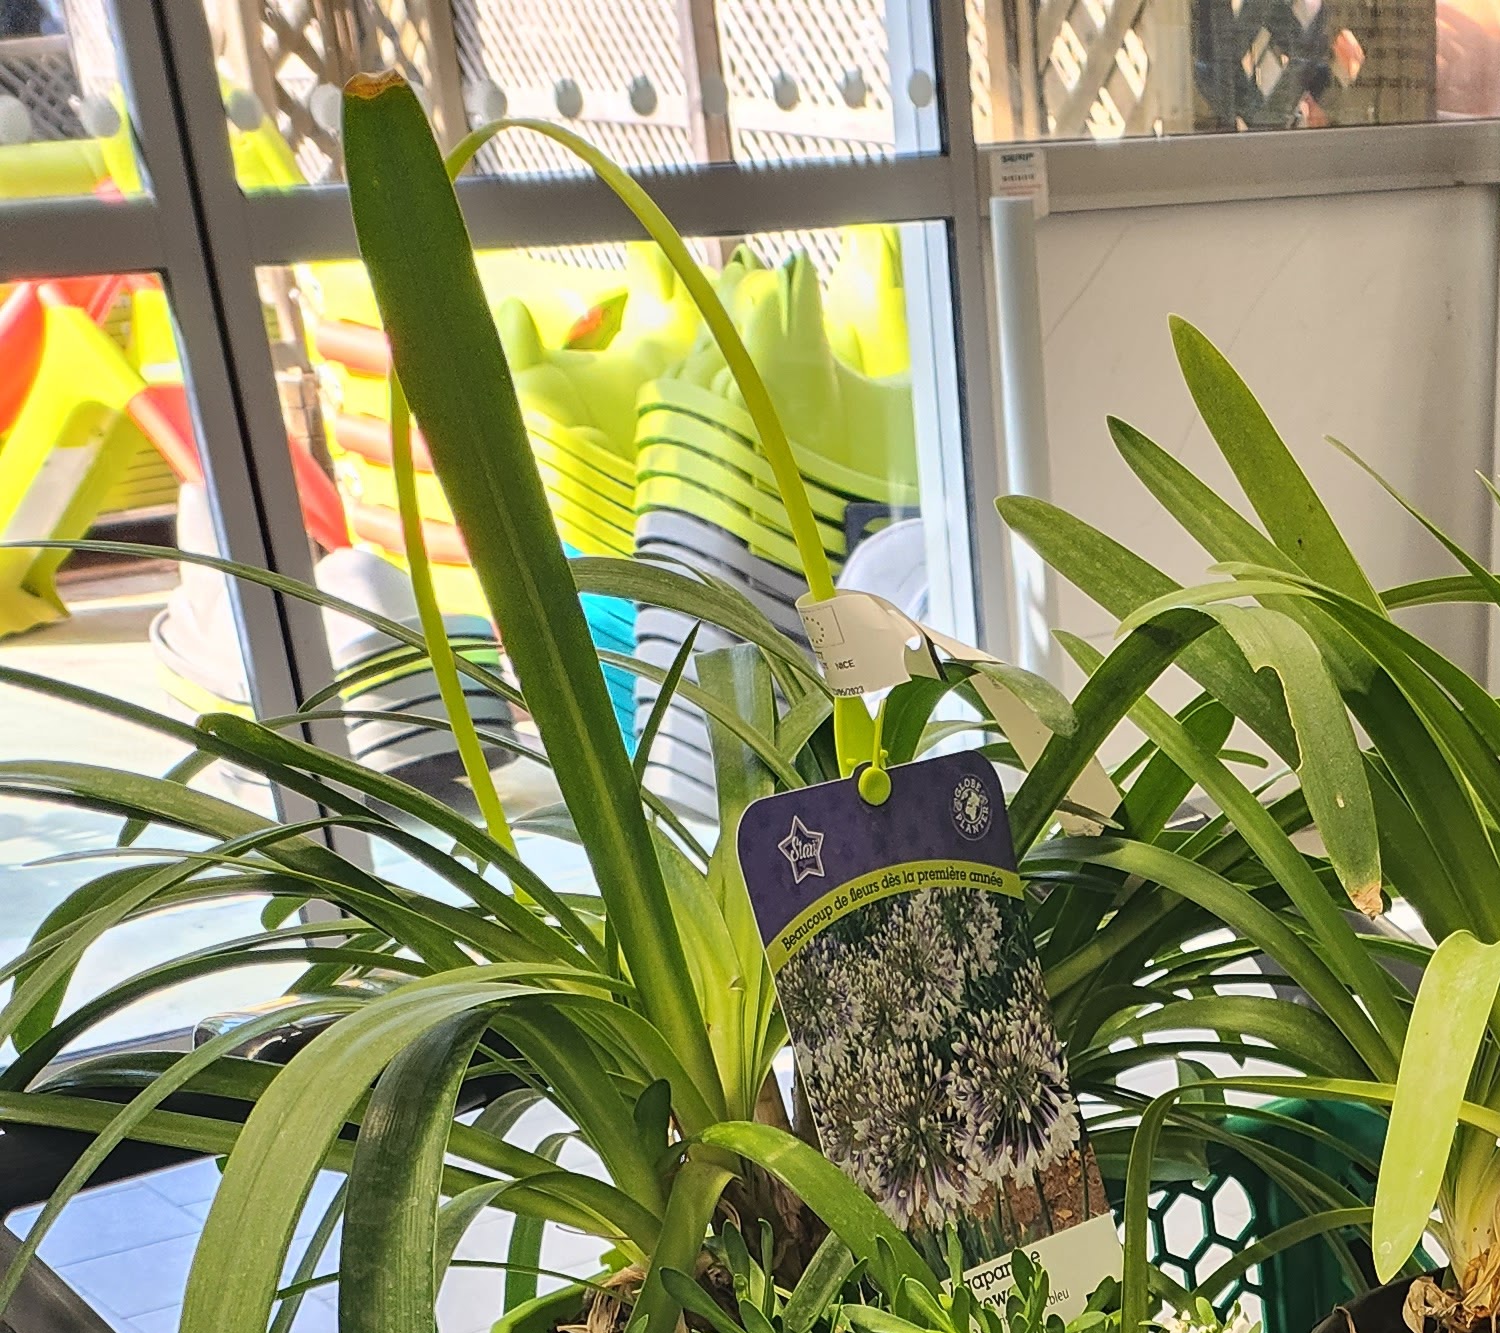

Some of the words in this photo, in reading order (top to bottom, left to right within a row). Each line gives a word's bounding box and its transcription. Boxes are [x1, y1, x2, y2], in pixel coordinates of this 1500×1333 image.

[835, 659, 856, 670] NICE
[954, 777, 982, 798] GLOBE
[954, 806, 989, 834] PLANTER
[781, 904, 834, 952] Beaucoup
[834, 892, 849, 911] de
[849, 879, 881, 904] fleurs
[881, 872, 901, 890] dès
[903, 869, 916, 884] la
[917, 864, 967, 886] première
[969, 871, 1004, 888] année
